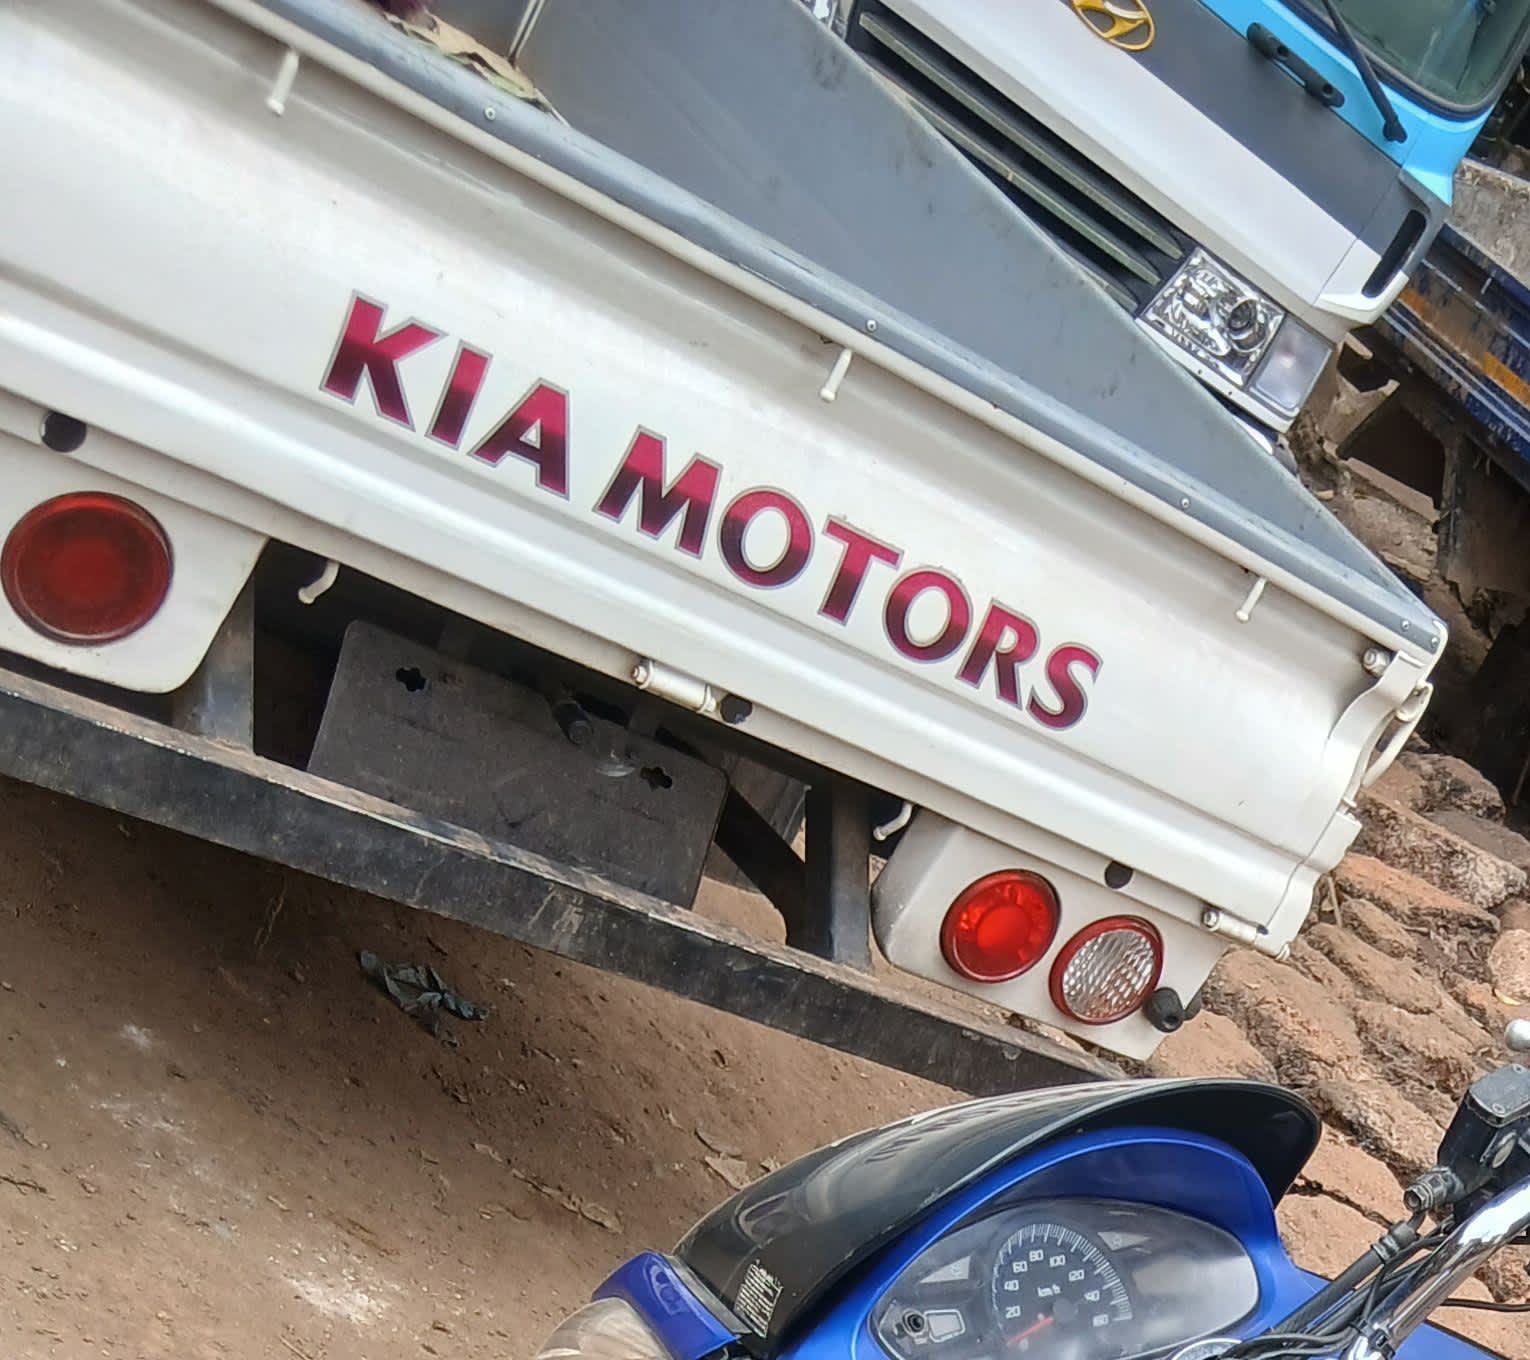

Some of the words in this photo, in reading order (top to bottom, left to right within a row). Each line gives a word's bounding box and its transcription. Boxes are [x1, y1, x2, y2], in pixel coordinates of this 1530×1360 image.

[319, 290, 572, 499] KIA
[594, 425, 1104, 733] MOTORS
[1049, 1255, 1066, 1267] 100
[1005, 1305, 1021, 1319] 20
